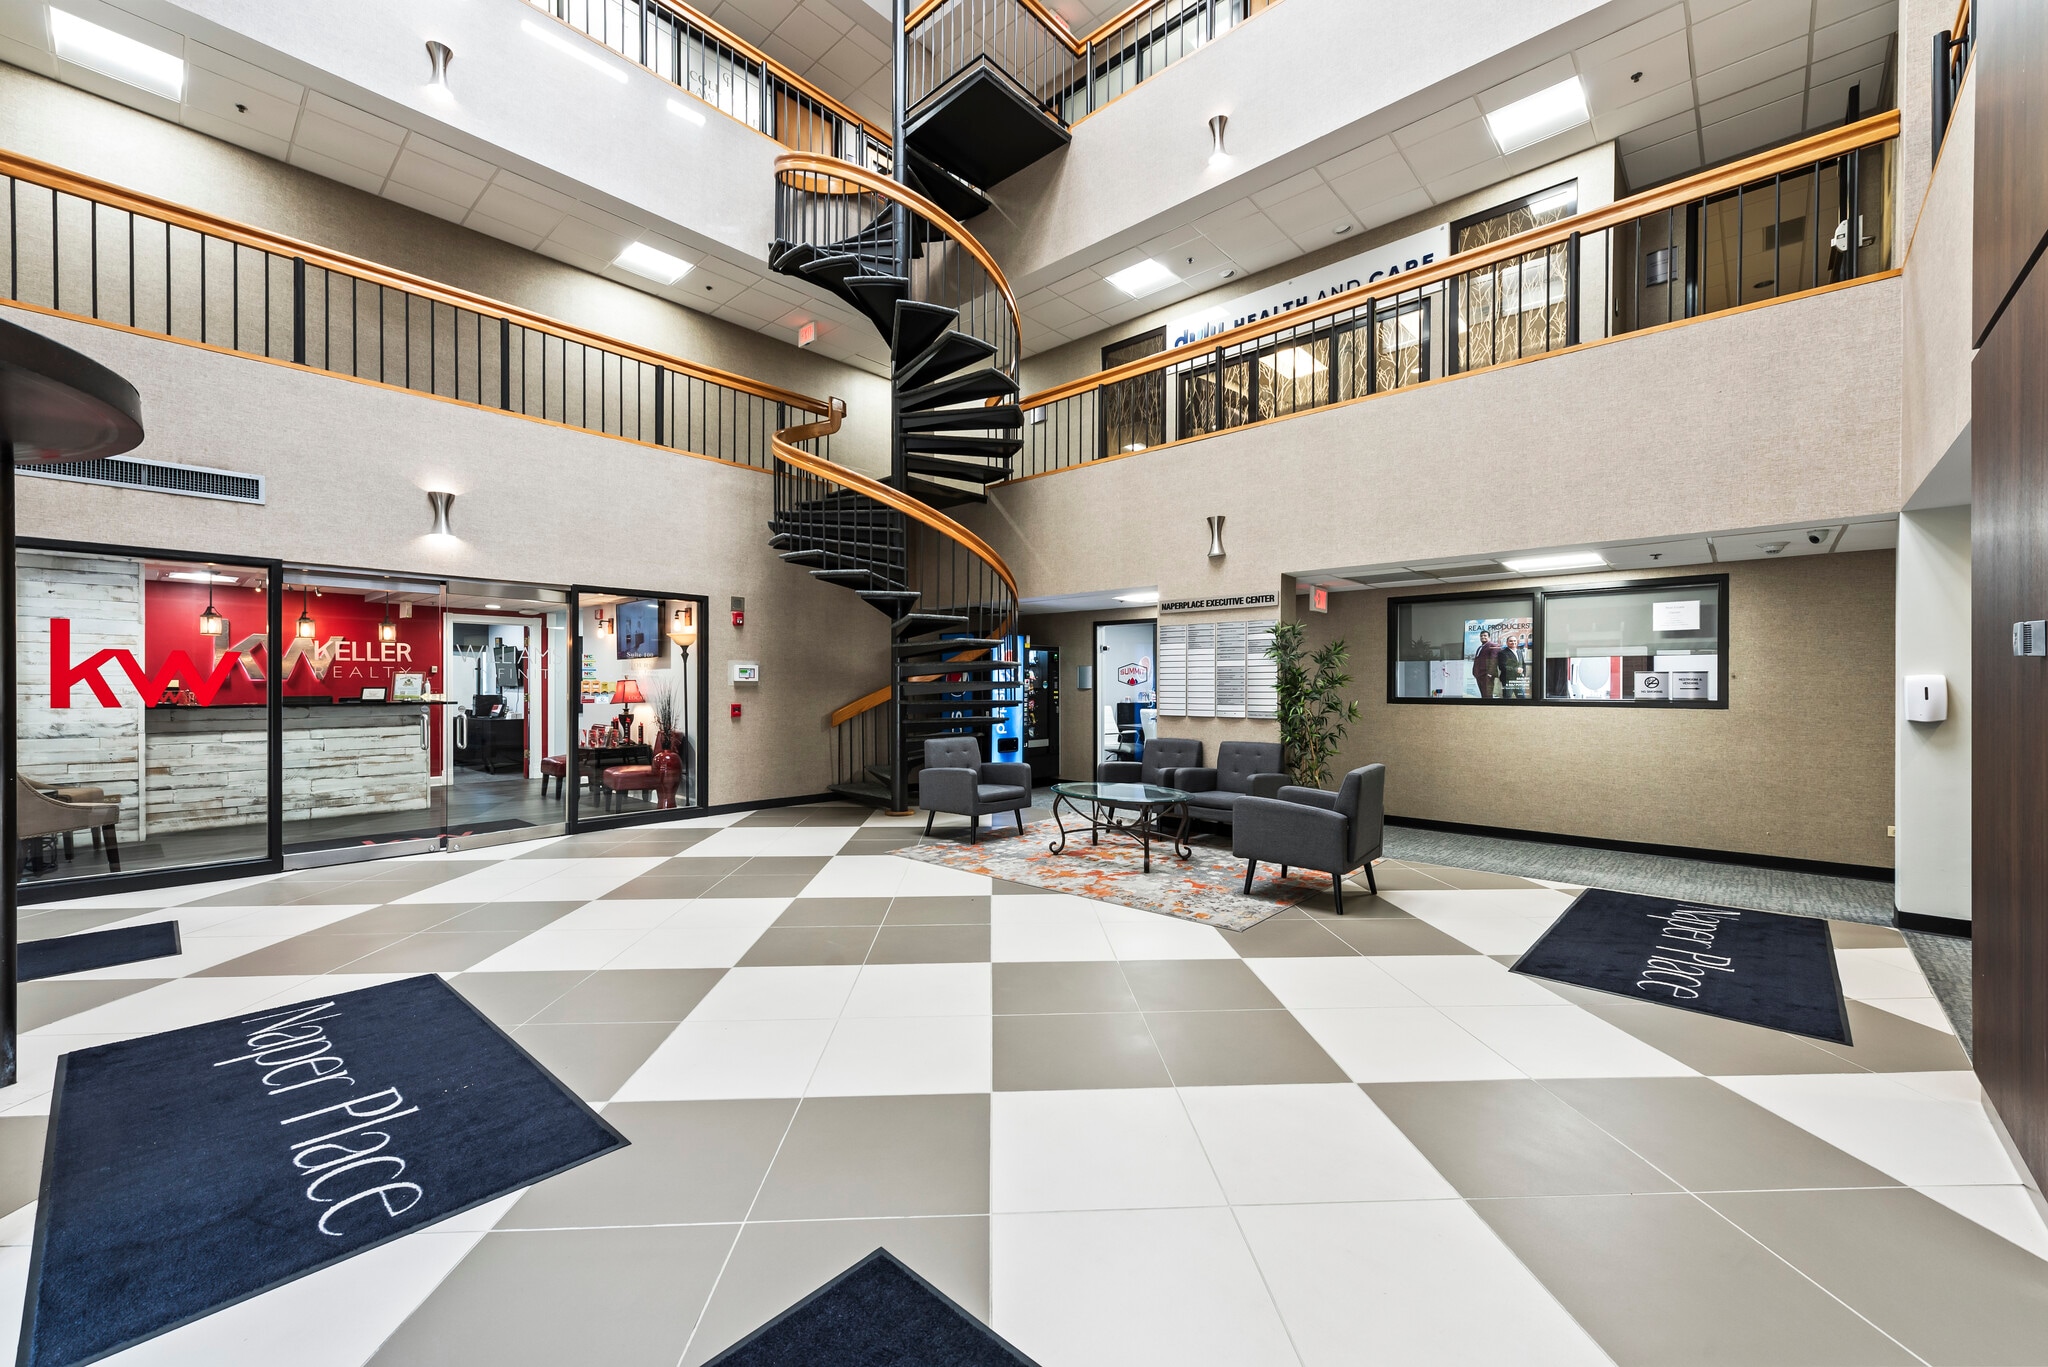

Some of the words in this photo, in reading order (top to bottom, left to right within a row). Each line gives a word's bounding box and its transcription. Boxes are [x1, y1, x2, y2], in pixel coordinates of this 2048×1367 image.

[1234, 296, 1307, 328] HEALTH
[1318, 280, 1360, 300] AND
[1369, 253, 1434, 283] CARE
[1161, 600, 1205, 611] NAPERPLACE
[1206, 597, 1244, 608] EXECUTIVE
[1246, 594, 1275, 604] CENTER
[1487, 622, 1531, 631] PRODUCERS
[313, 640, 412, 663] KELLER
[313, 666, 412, 679] REALTY
[1120, 667, 1146, 676] SUMMIT
[1646, 904, 1741, 949] Naper
[1636, 945, 1735, 999] Place
[213, 1001, 355, 1096] Naper
[280, 1086, 423, 1237] Place
